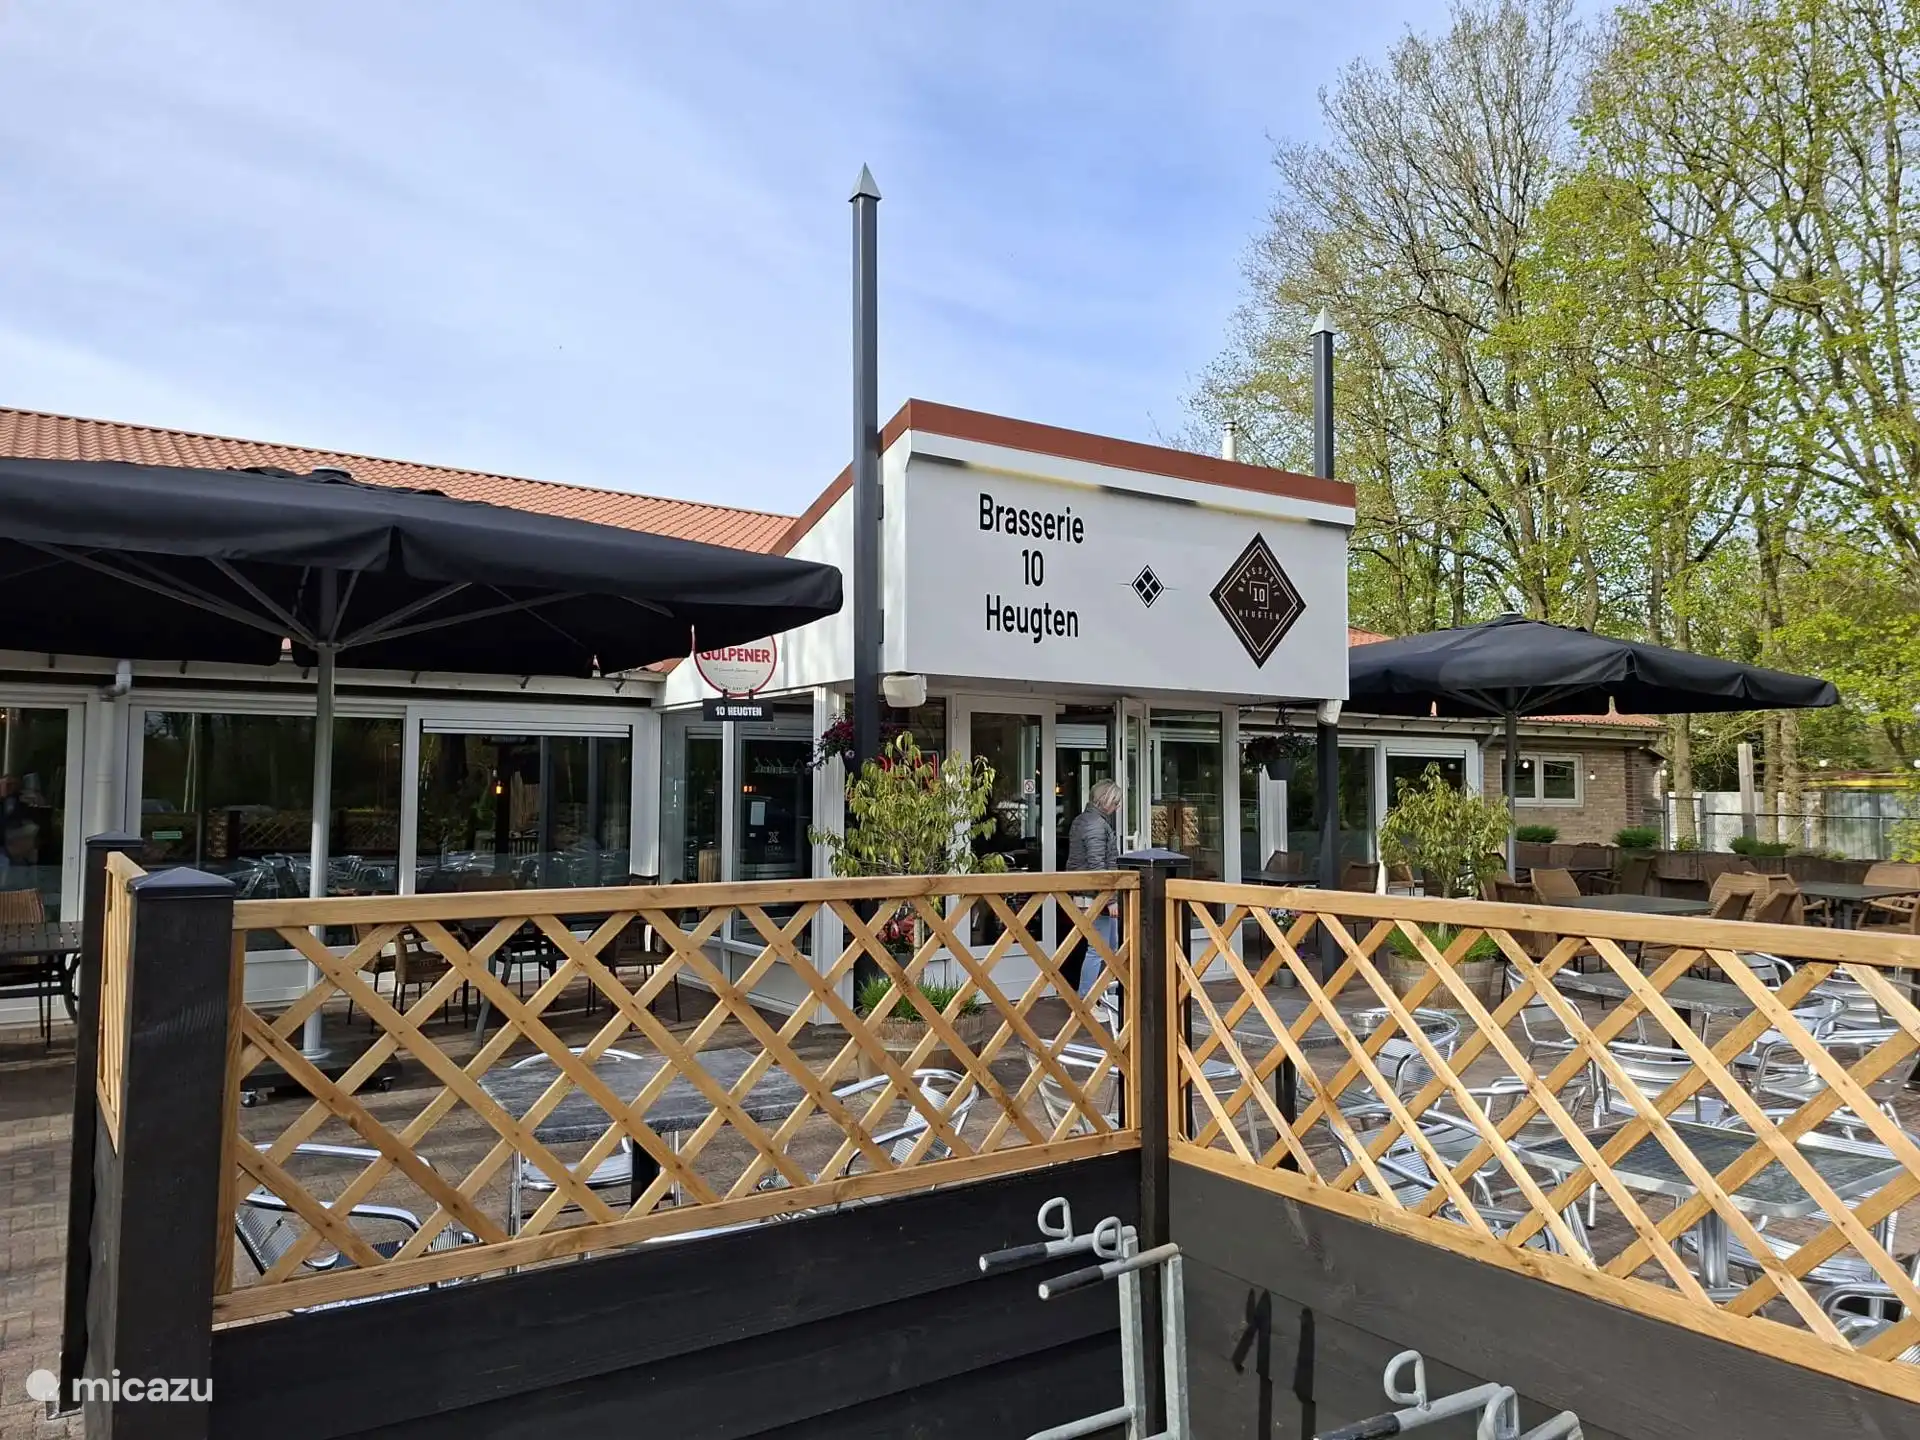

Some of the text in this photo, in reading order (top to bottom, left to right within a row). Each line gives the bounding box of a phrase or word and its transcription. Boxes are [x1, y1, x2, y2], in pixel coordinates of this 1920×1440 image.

[979, 493, 1084, 544] Brasserie
[1021, 549, 1044, 587] 10
[1253, 587, 1265, 602] 10
[986, 594, 1078, 644] Heugten
[701, 648, 771, 663] GULPENER
[715, 706, 762, 717] 10 HEUGTEN
